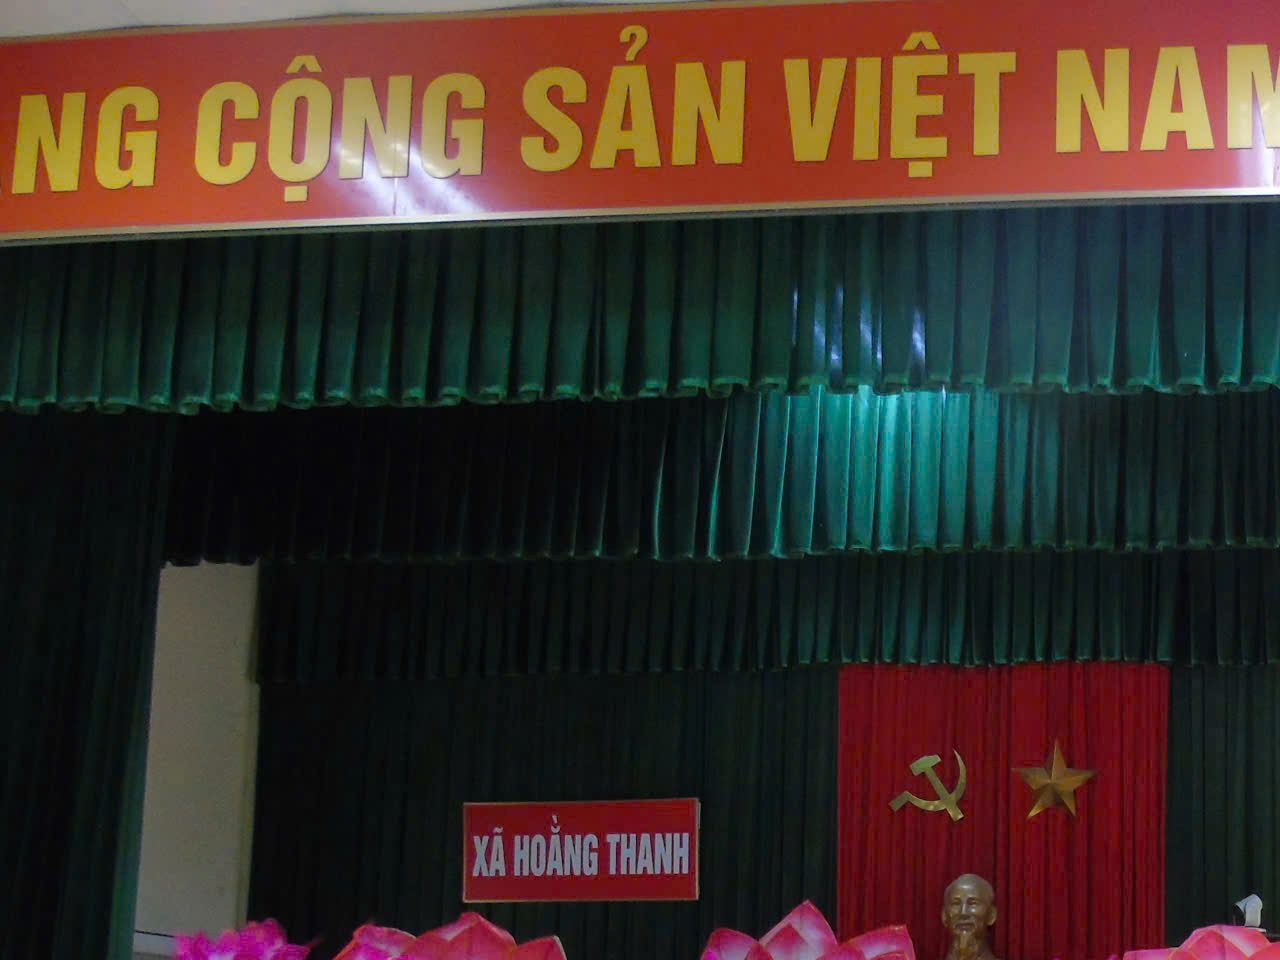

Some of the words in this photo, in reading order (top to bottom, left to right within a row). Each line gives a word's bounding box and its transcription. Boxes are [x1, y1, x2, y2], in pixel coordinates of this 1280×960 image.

[11, 86, 160, 195] NG
[194, 54, 486, 203] CỘNG
[519, 25, 748, 173] SẢN
[783, 31, 1017, 179] VIỆT
[472, 827, 507, 877] XÃ
[513, 815, 599, 877] HOẰNG
[605, 832, 690, 875] THANH
